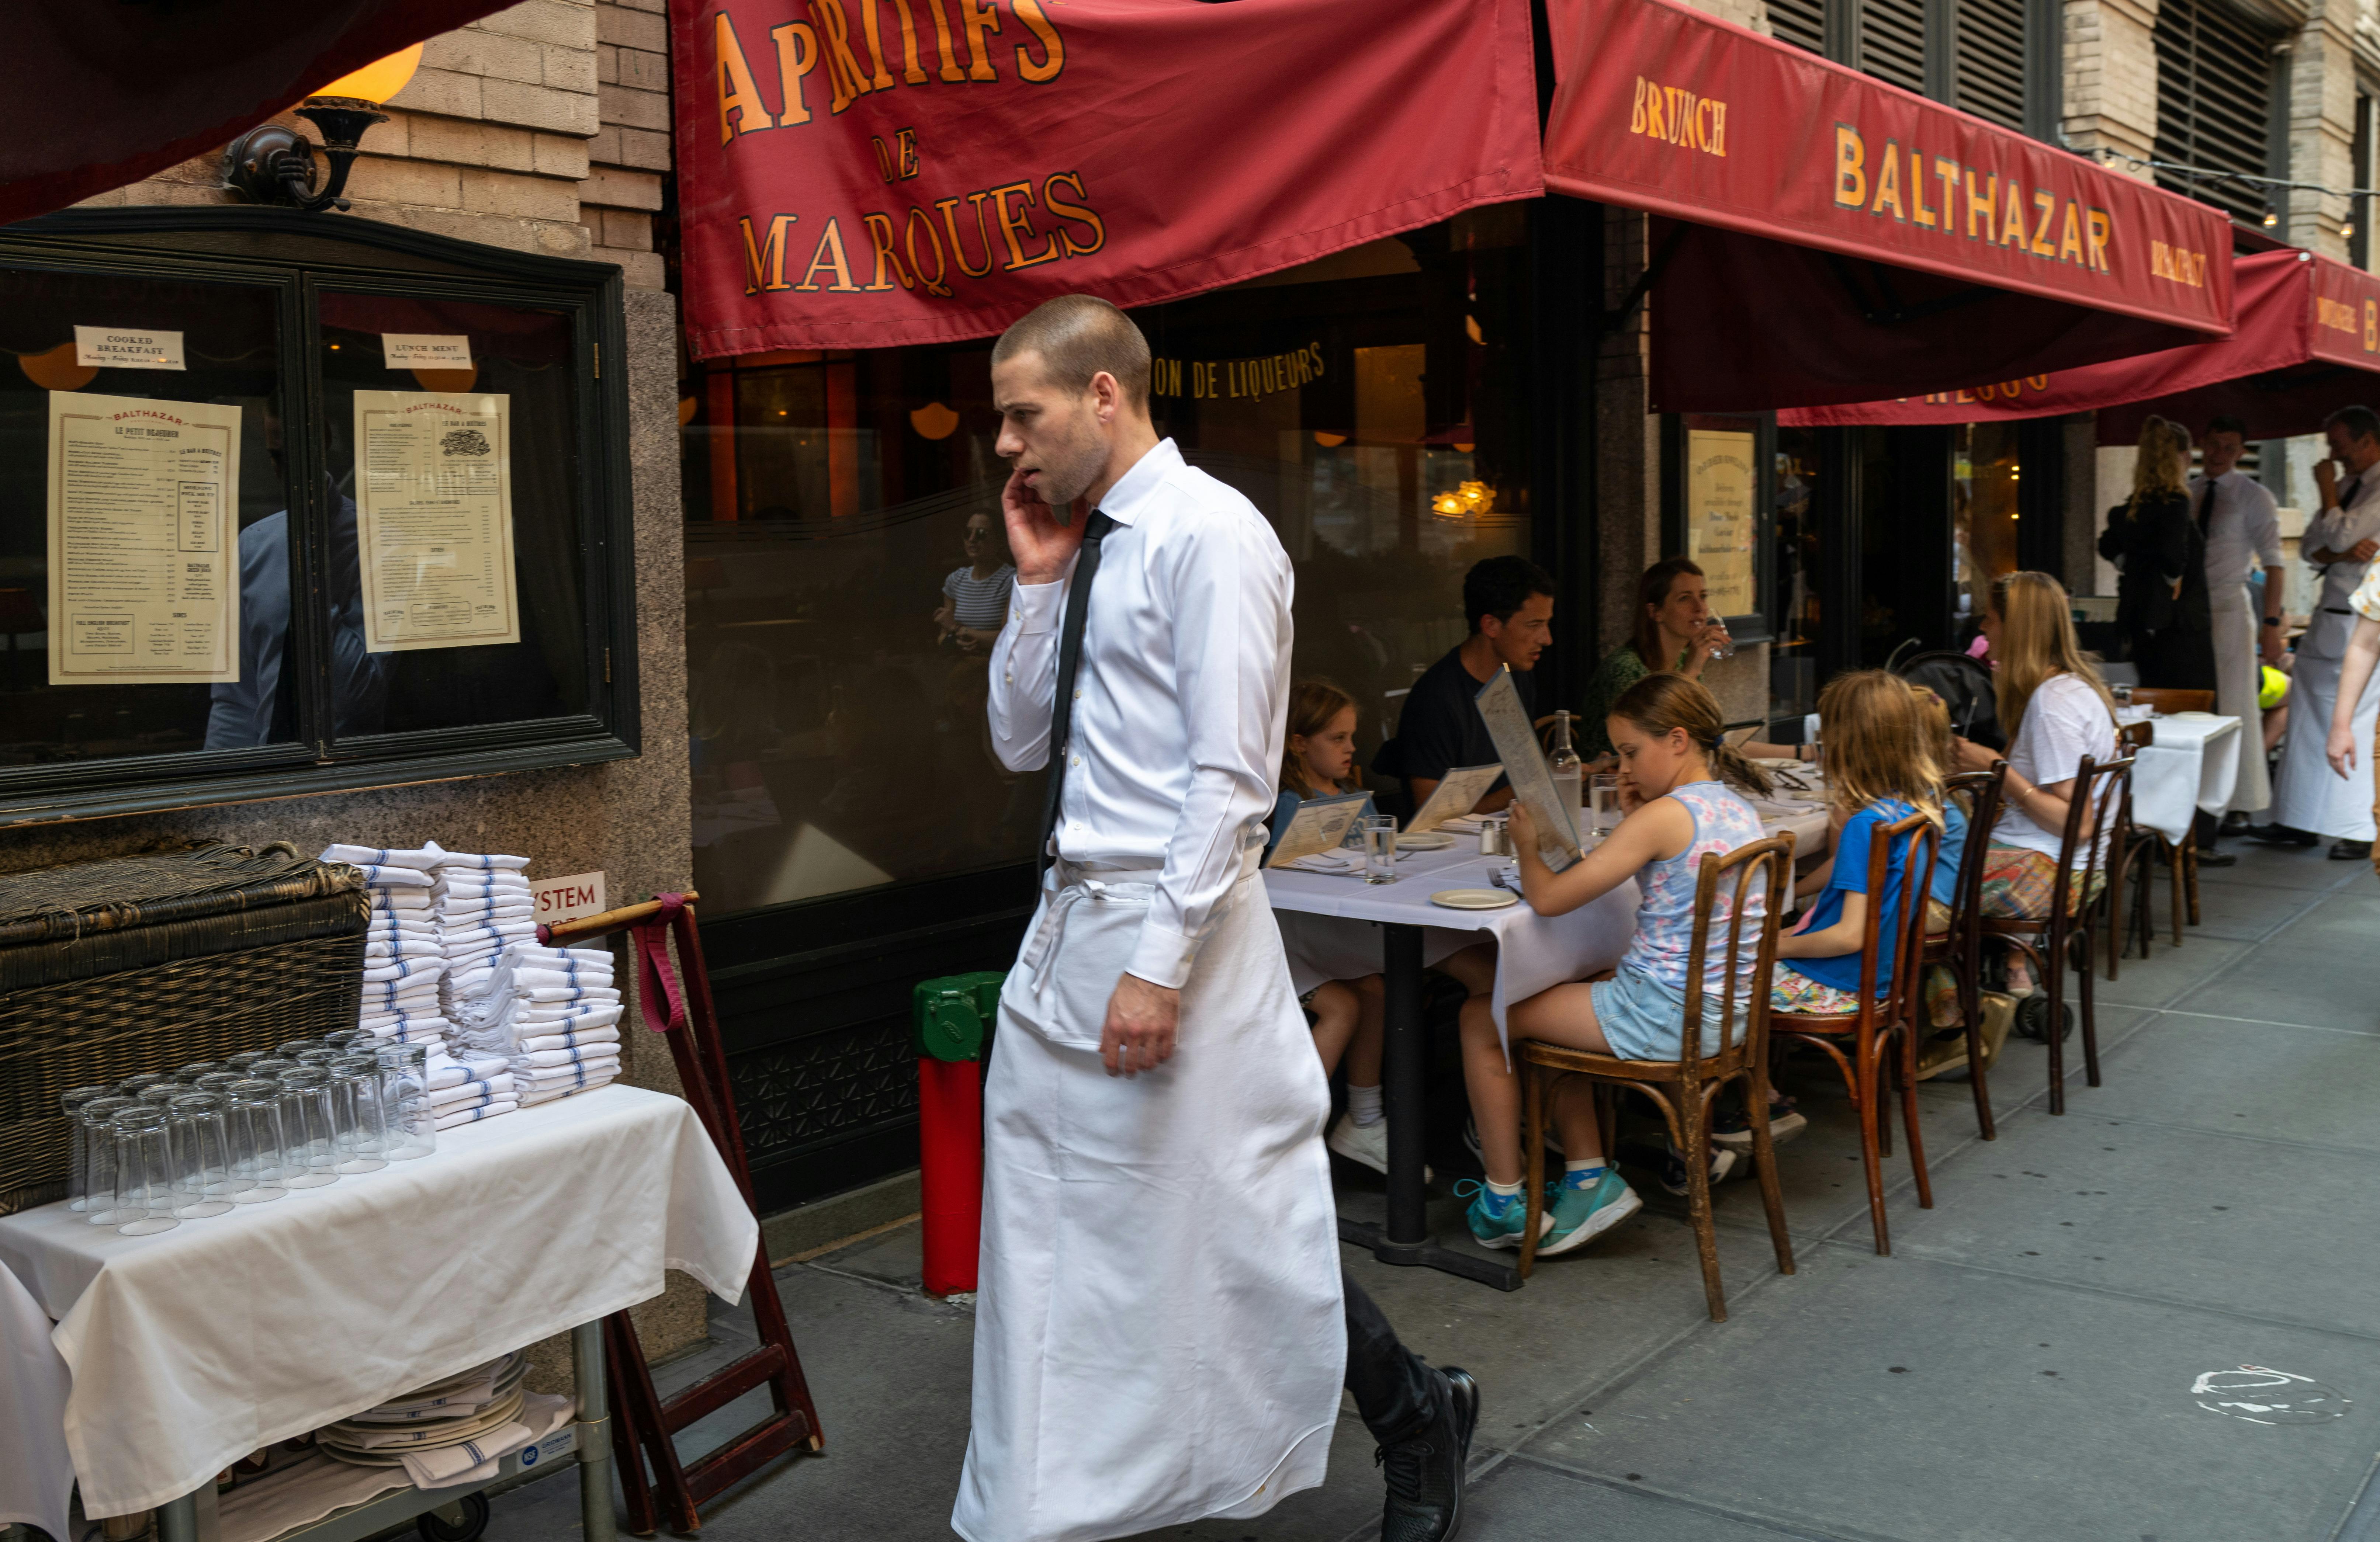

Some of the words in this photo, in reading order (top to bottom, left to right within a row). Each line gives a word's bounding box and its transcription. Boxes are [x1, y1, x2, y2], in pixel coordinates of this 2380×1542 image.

[1630, 75, 1727, 157] BRUNCH
[871, 127, 919, 184] DE
[1834, 121, 2111, 275] BALTHAZAR
[739, 171, 1106, 299] MARQUES
[97, 345, 164, 354] BREAKFAST
[107, 336, 153, 344] COOKED
[1193, 361, 1217, 399] DE
[1228, 341, 1324, 403] LIQUEURS
[114, 410, 183, 426] BALTHAZAR
[406, 403, 462, 414] BALTHAZAR
[126, 427, 145, 436] PETIT
